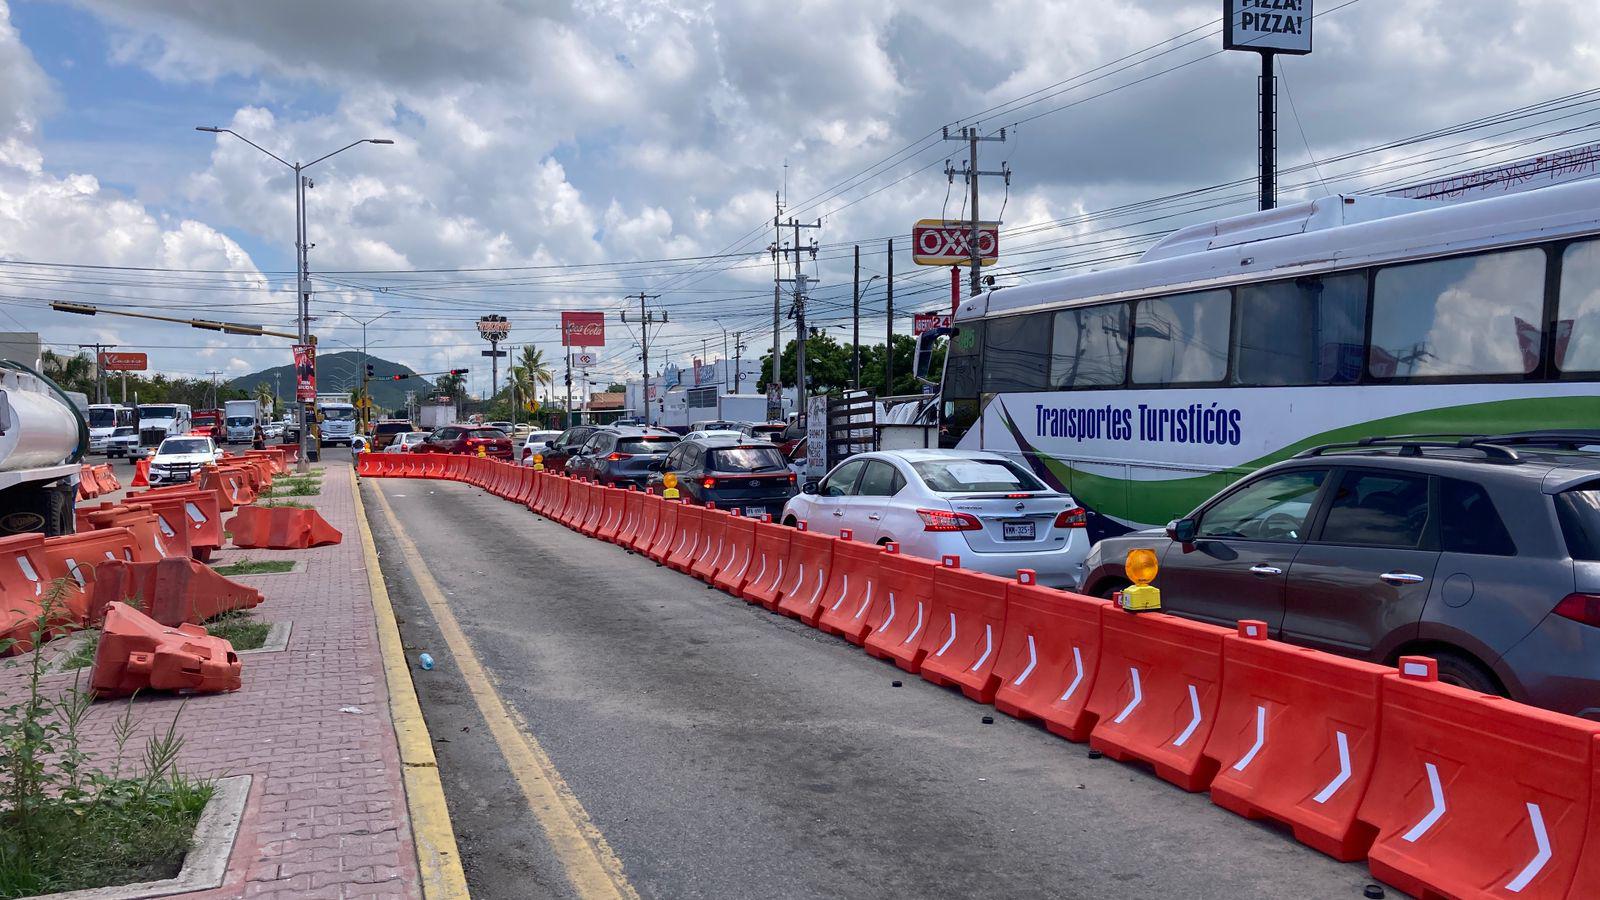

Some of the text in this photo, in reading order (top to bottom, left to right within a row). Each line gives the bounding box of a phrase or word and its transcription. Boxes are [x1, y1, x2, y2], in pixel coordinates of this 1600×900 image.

[1242, 12, 1302, 35] PIZZA!
[920, 230, 996, 255] OXXO
[933, 316, 950, 329] 24
[1036, 404, 1132, 442] Transportes
